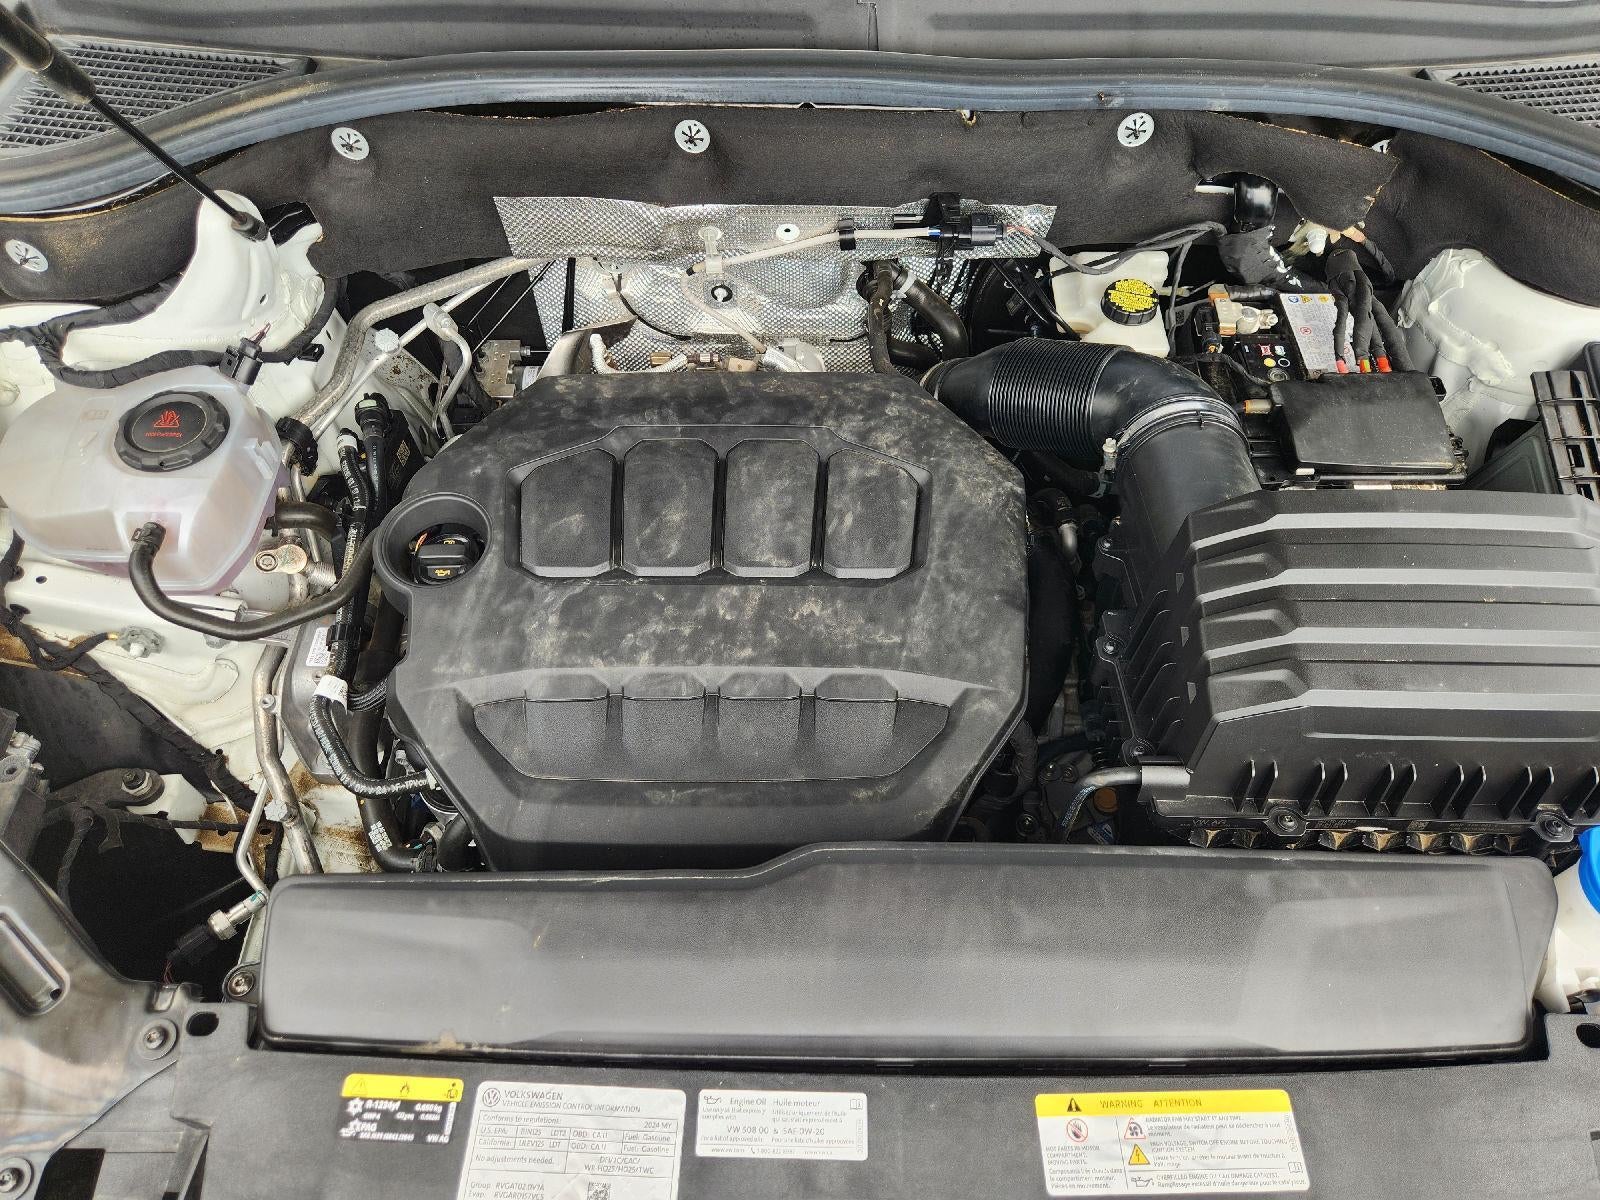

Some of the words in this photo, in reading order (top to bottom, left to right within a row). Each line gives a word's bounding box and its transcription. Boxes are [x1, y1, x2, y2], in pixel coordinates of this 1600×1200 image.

[504, 1090, 563, 1100] VOLKSWAGEN
[530, 1101, 561, 1109] EMISSION
[1100, 1099, 1143, 1109] WARNING
[1153, 1097, 1202, 1107] ATTENTION
[644, 1121, 660, 1129] 2024
